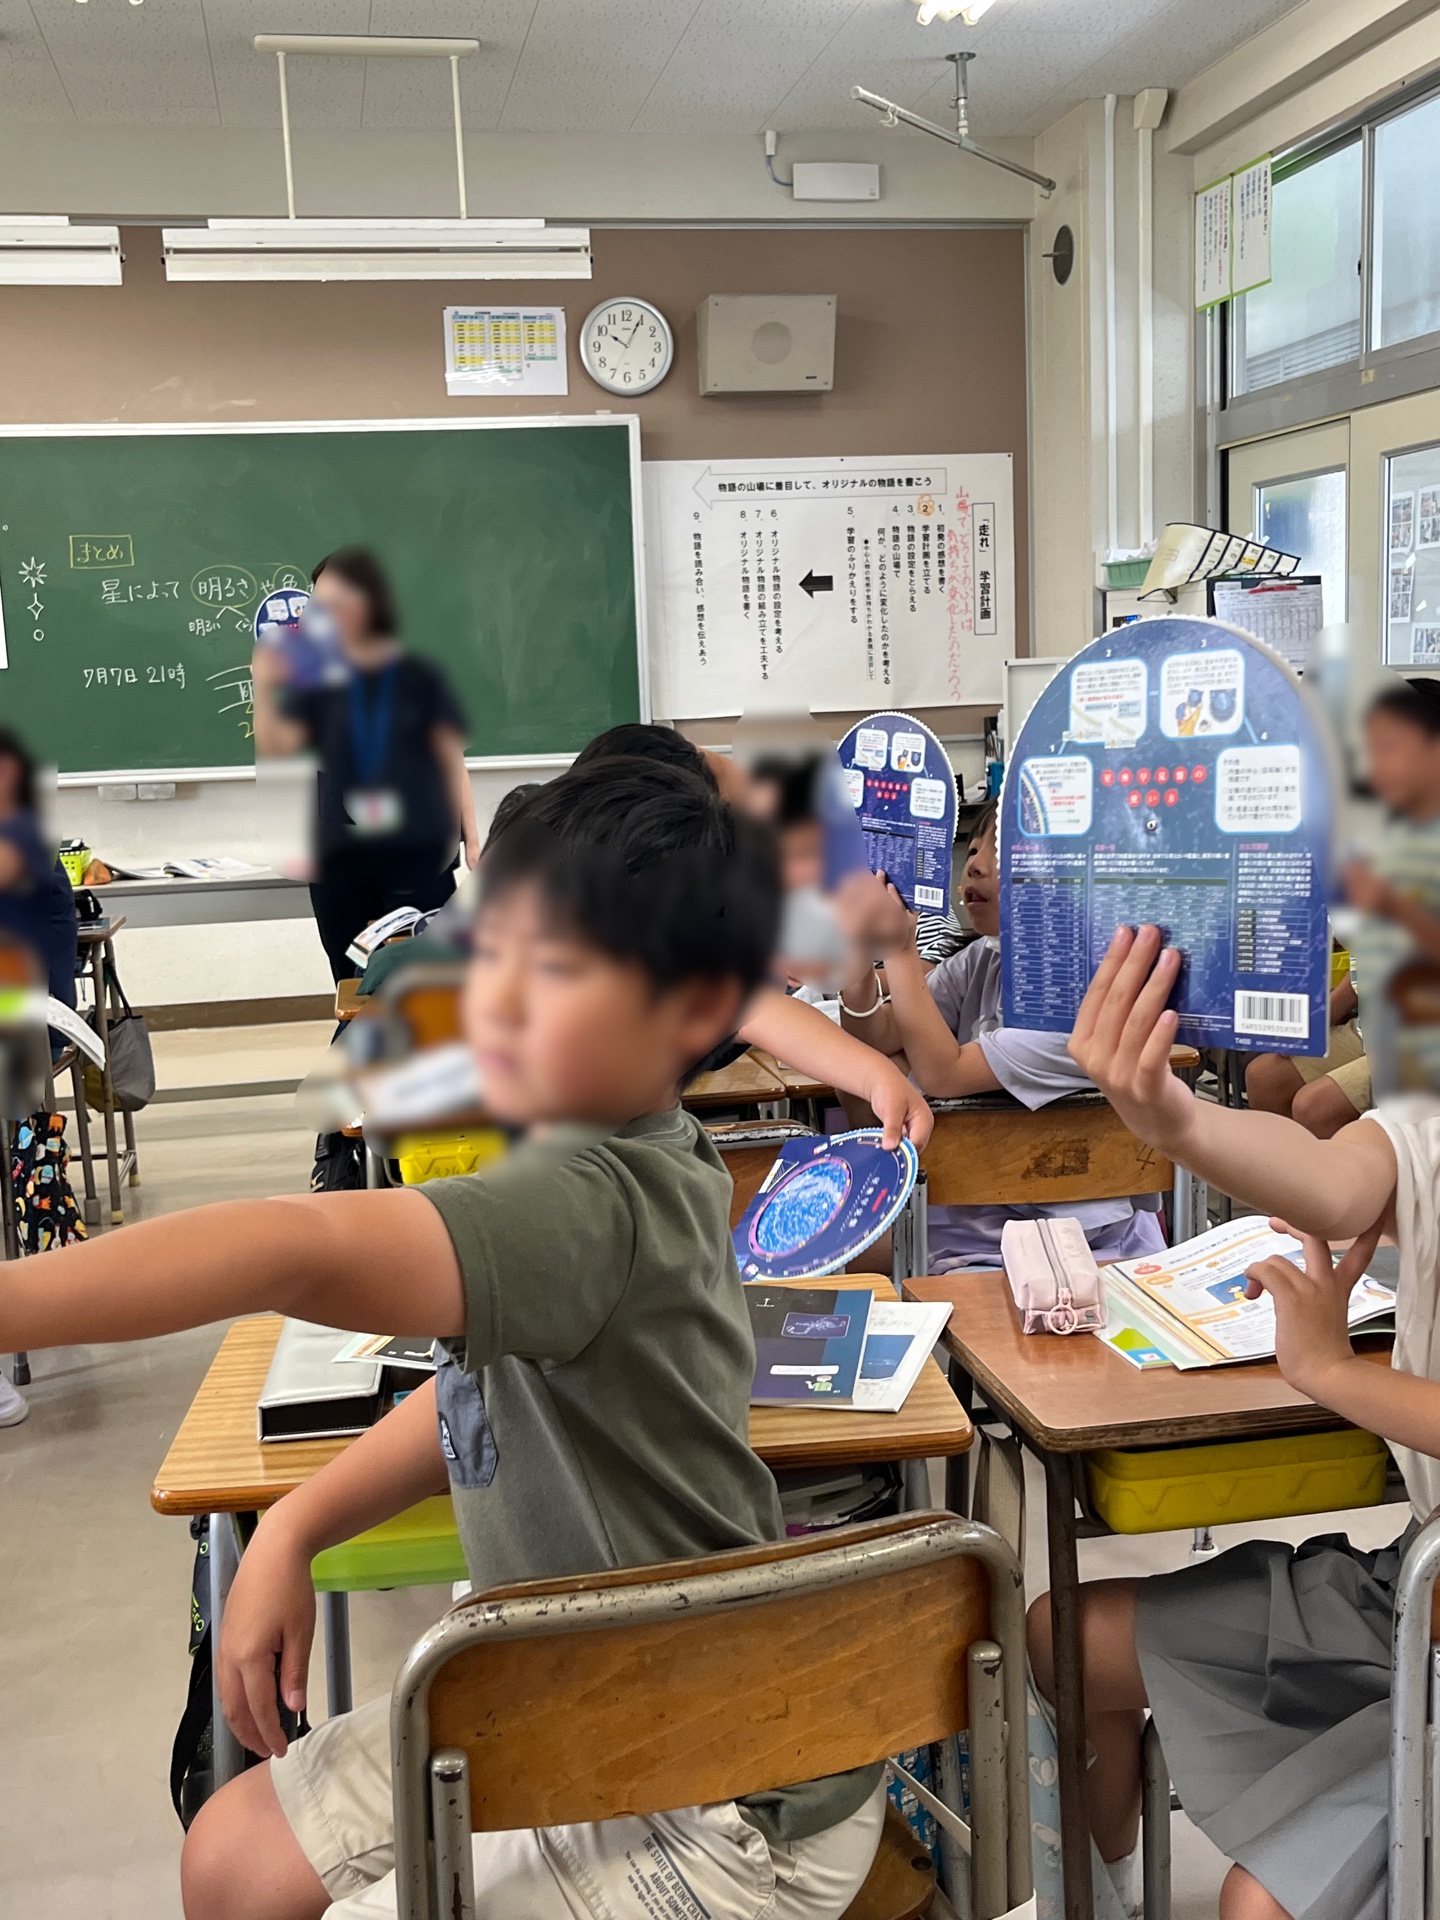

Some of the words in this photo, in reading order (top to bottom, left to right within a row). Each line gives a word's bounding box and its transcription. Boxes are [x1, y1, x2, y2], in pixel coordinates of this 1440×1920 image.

[607, 314, 616, 325] 11
[621, 310, 632, 322] 12
[597, 325, 608, 337] 10
[649, 326, 656, 338] 2
[593, 341, 601, 353] 9
[654, 342, 662, 353] 3
[599, 357, 607, 368] 8
[649, 357, 655, 368] 4
[610, 368, 617, 380] 7
[623, 371, 631, 383] 6
[639, 369, 646, 380] 5
[718, 476, 932, 493] 物語の山場に着目して、オリジナルの物語を書こう
[979, 518, 990, 553] 「走れ」
[76, 541, 124, 563] まとめ
[101, 578, 180, 605] 星によって
[979, 570, 991, 620] 学習計画
[1200, 639, 1207, 647] 3
[1105, 649, 1111, 657] 2
[83, 666, 138, 688] 7月7日
[146, 662, 186, 689] 21時
[1260, 732, 1268, 741] 4
[643, 1836, 656, 1852] THE
[651, 1849, 669, 1873] STATE
[665, 1871, 676, 1882] OF
[671, 1881, 691, 1906] BEING
[650, 1872, 670, 1897] ABOUT
